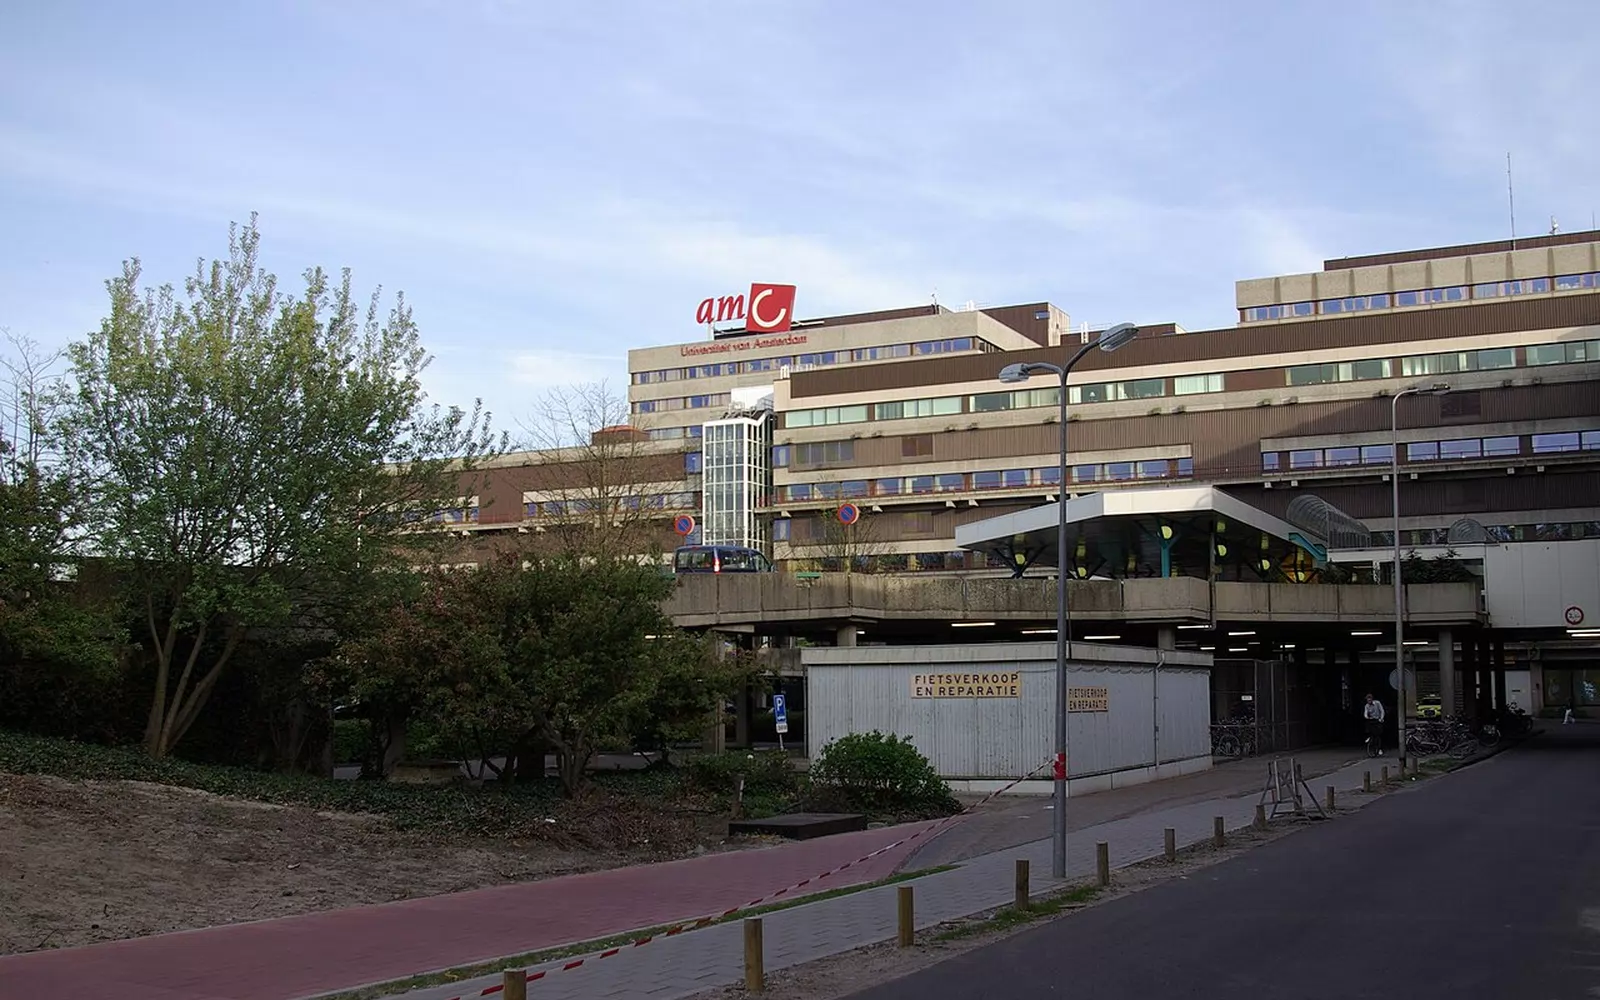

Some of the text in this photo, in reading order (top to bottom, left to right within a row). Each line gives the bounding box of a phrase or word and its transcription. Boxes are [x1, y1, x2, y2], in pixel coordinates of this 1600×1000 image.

[681, 335, 807, 356] Universiteit van Amsterdam
[915, 674, 1019, 685] FIETSVERKOOP
[916, 685, 1018, 697] EN REPARATIE
[776, 697, 783, 711] P
[1069, 700, 1077, 710] EN
